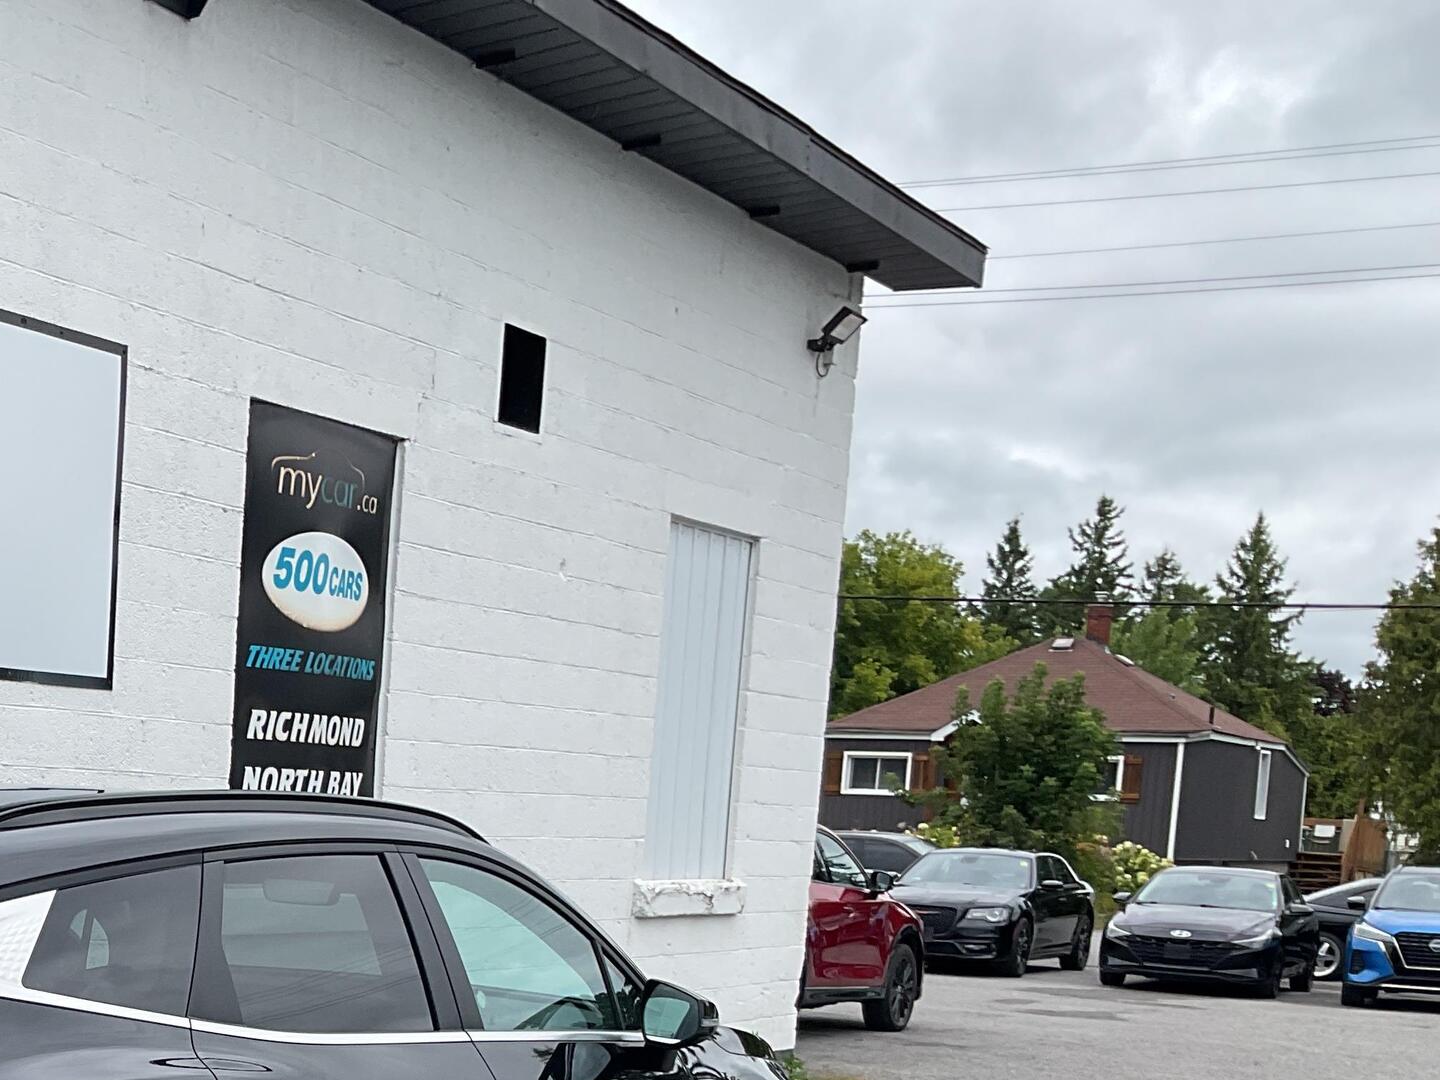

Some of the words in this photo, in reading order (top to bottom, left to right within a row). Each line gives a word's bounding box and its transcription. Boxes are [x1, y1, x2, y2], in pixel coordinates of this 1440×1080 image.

[273, 546, 328, 595] 500
[328, 567, 363, 602] CARS
[246, 645, 302, 673] THREE
[304, 651, 376, 681] LOCATIONS
[246, 709, 365, 748] RICHMOND
[242, 766, 325, 793] NORTH
[326, 770, 363, 797] BAY
